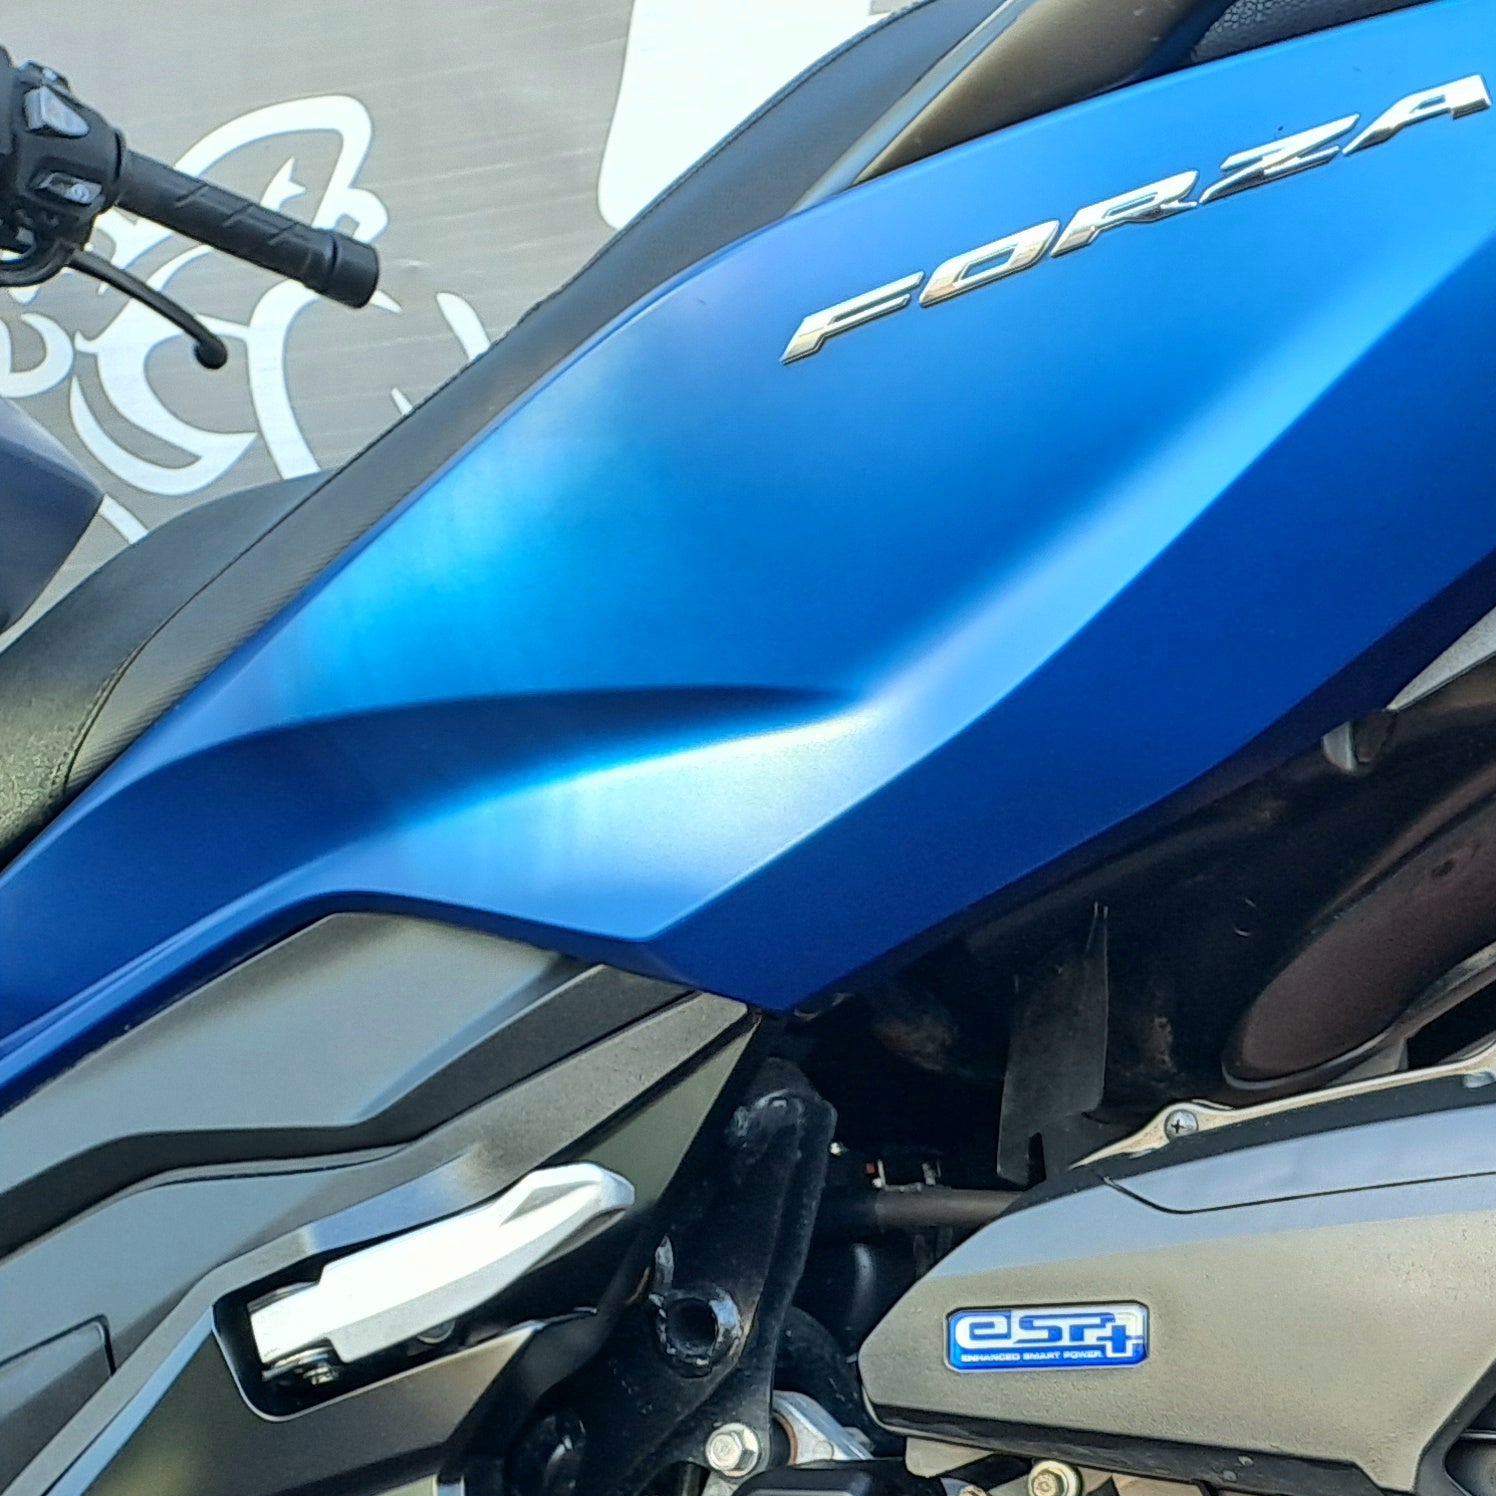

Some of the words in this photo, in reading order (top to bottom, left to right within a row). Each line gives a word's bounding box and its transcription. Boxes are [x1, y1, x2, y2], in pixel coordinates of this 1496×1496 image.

[779, 73, 1493, 365] FORZA
[961, 1353, 1021, 1363] ENHANCED
[1022, 1351, 1061, 1361] SMART
[1062, 1350, 1103, 1360] POWER
